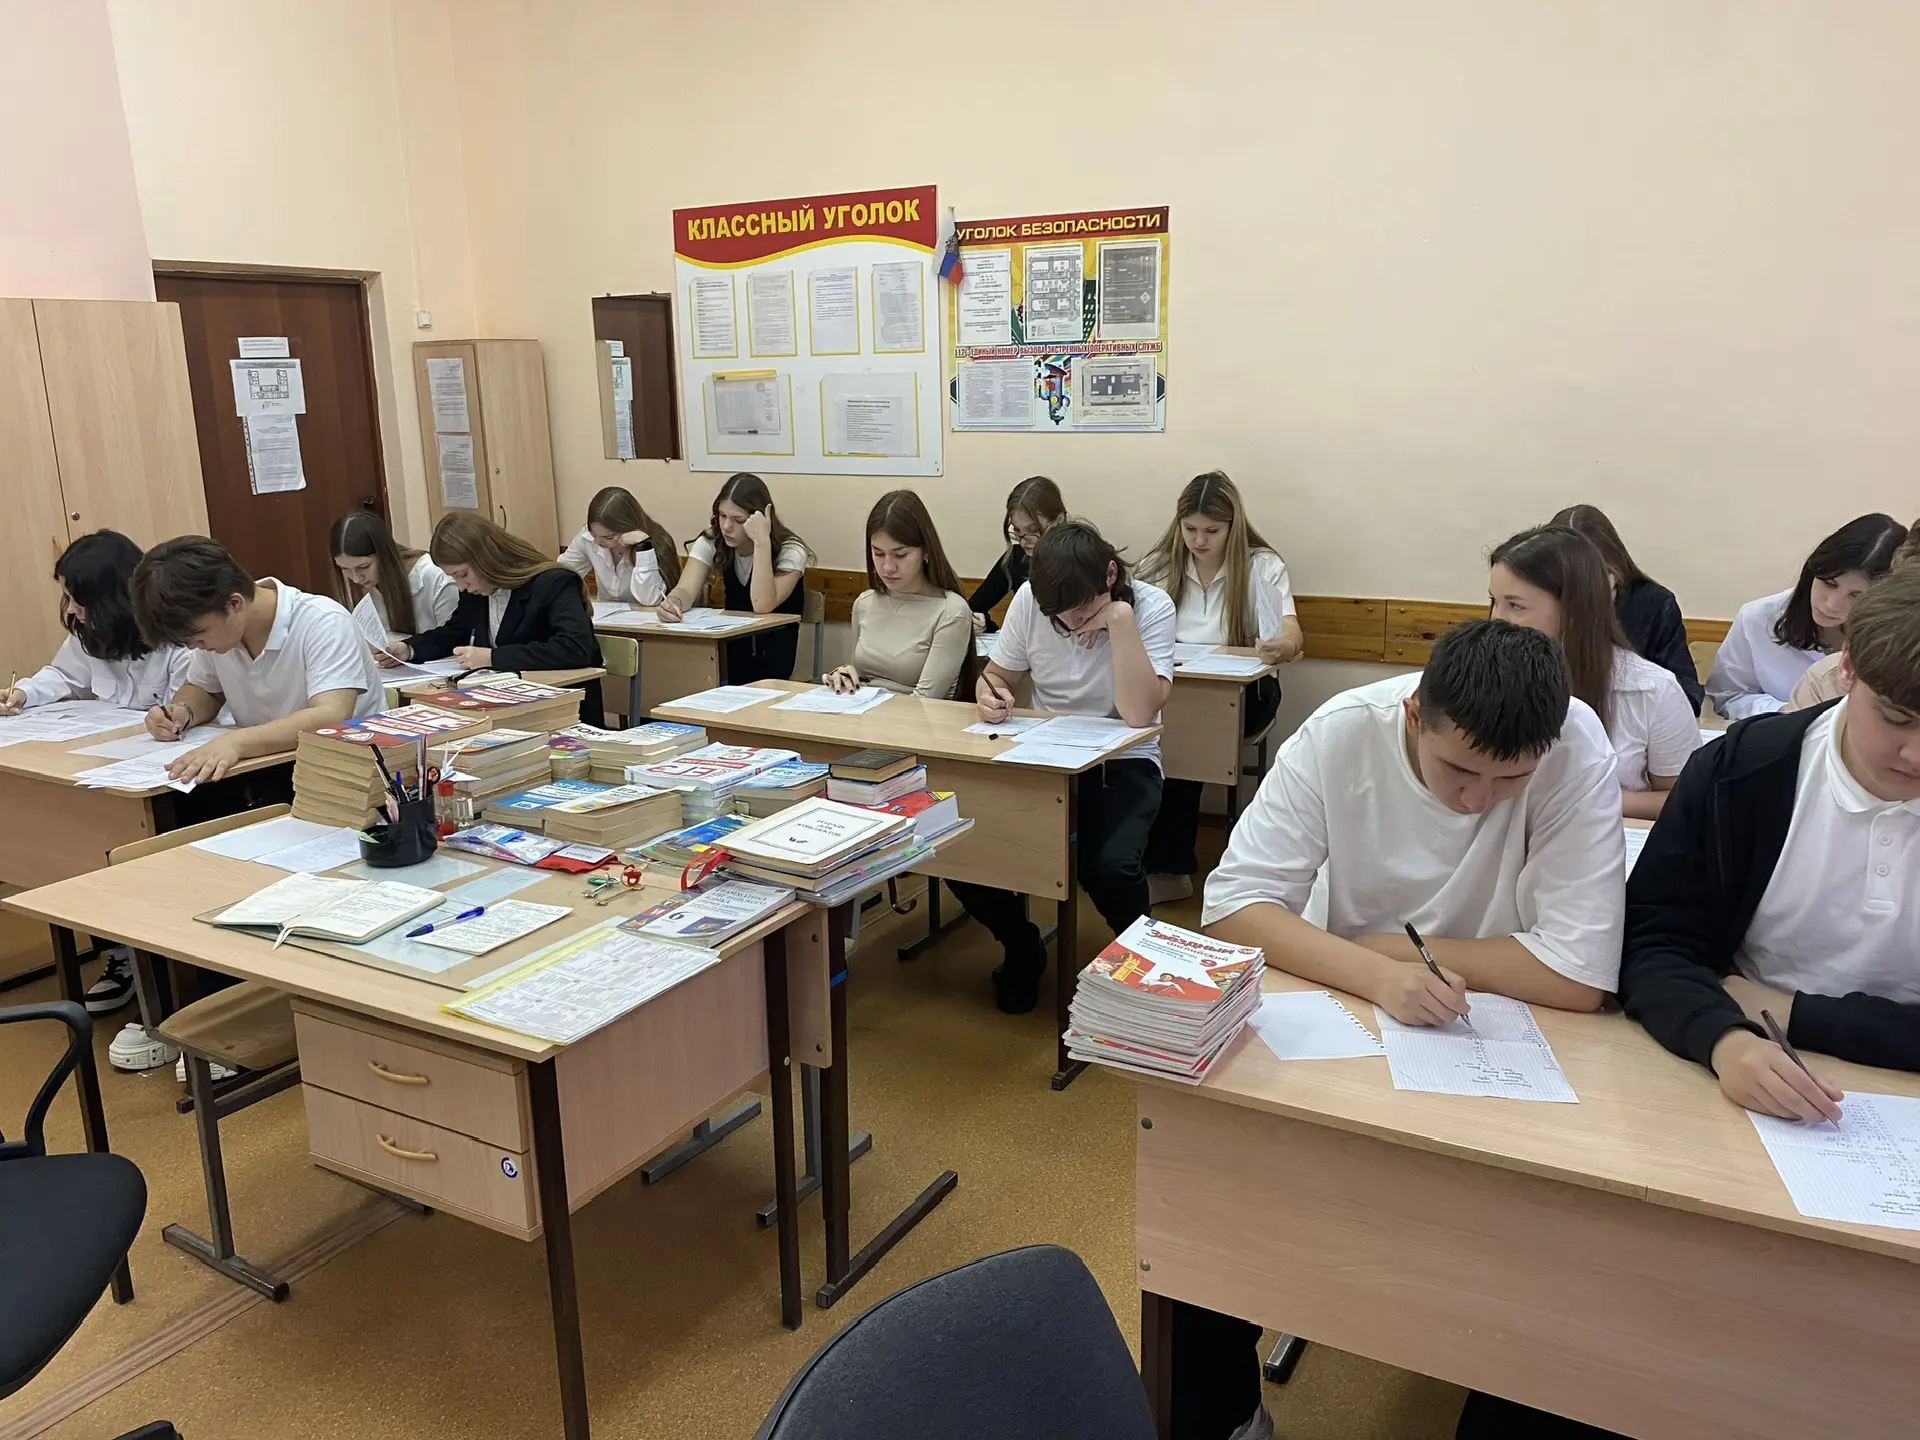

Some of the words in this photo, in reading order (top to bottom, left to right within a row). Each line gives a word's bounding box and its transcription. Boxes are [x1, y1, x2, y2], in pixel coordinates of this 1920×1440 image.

[687, 204, 815, 240] КЛАССНЫЙ
[823, 198, 921, 230] УГОЛОК
[956, 223, 1020, 241] УГОЛОК
[1021, 213, 1160, 237] БЕЗОПАСНОСТИ
[971, 347, 996, 356] ЕДИНЫЙ
[996, 347, 1018, 356] НОМЕР
[1019, 345, 1045, 354] ВЫЗОВА
[1046, 344, 1089, 354] ЭКСТРЕННЫХ
[1090, 343, 1136, 353] ОПЕРАТИВНЫХ
[1137, 342, 1161, 352] СЛУЖБ
[500, 683, 571, 699] ЕГЭ
[399, 709, 478, 728] ЕГЭ
[647, 764, 717, 778] ЕГЭ
[669, 911, 691, 921] 6
[1199, 959, 1217, 967] 9
